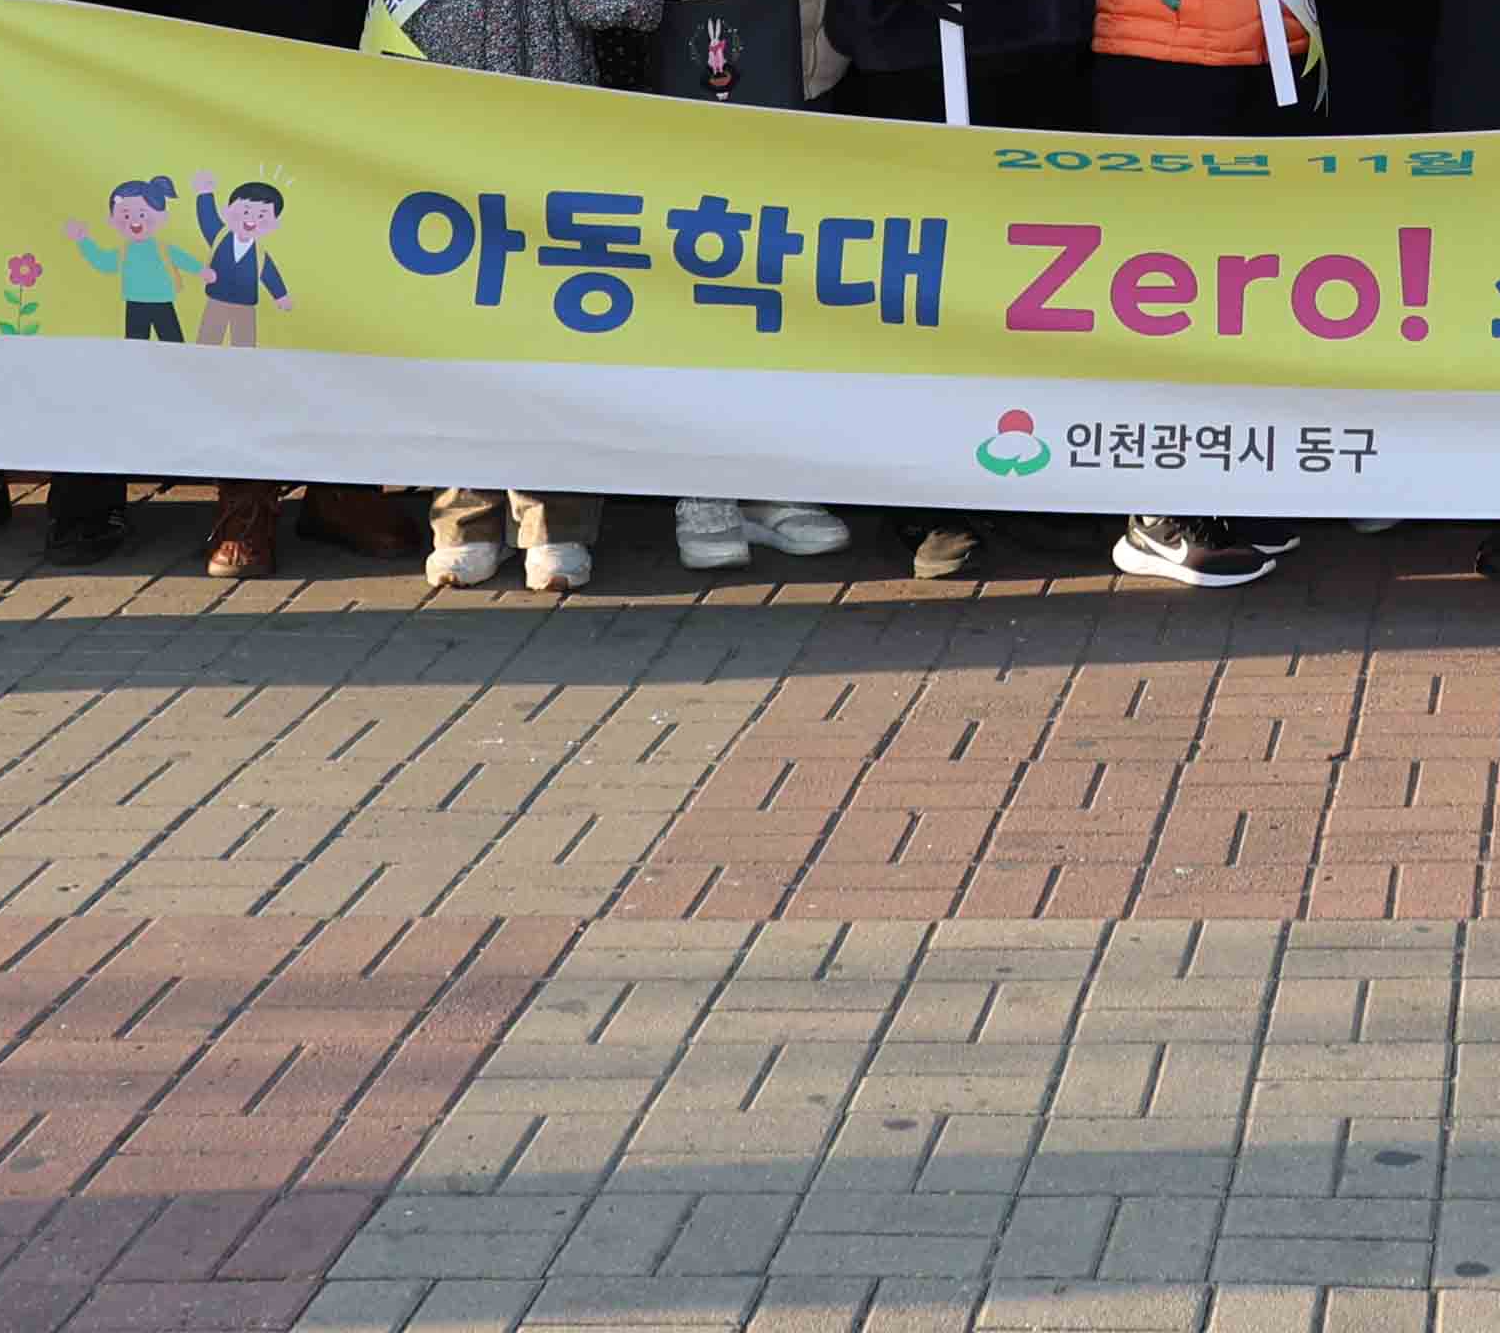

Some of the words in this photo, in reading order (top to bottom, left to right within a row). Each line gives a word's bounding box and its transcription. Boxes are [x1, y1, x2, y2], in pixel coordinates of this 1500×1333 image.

[1307, 146, 1475, 178] 11월
[387, 188, 948, 334] 아동학대
[1004, 221, 1433, 343] Zero!
[1065, 422, 1278, 473] 인천광역시
[1295, 426, 1380, 475] 동구
